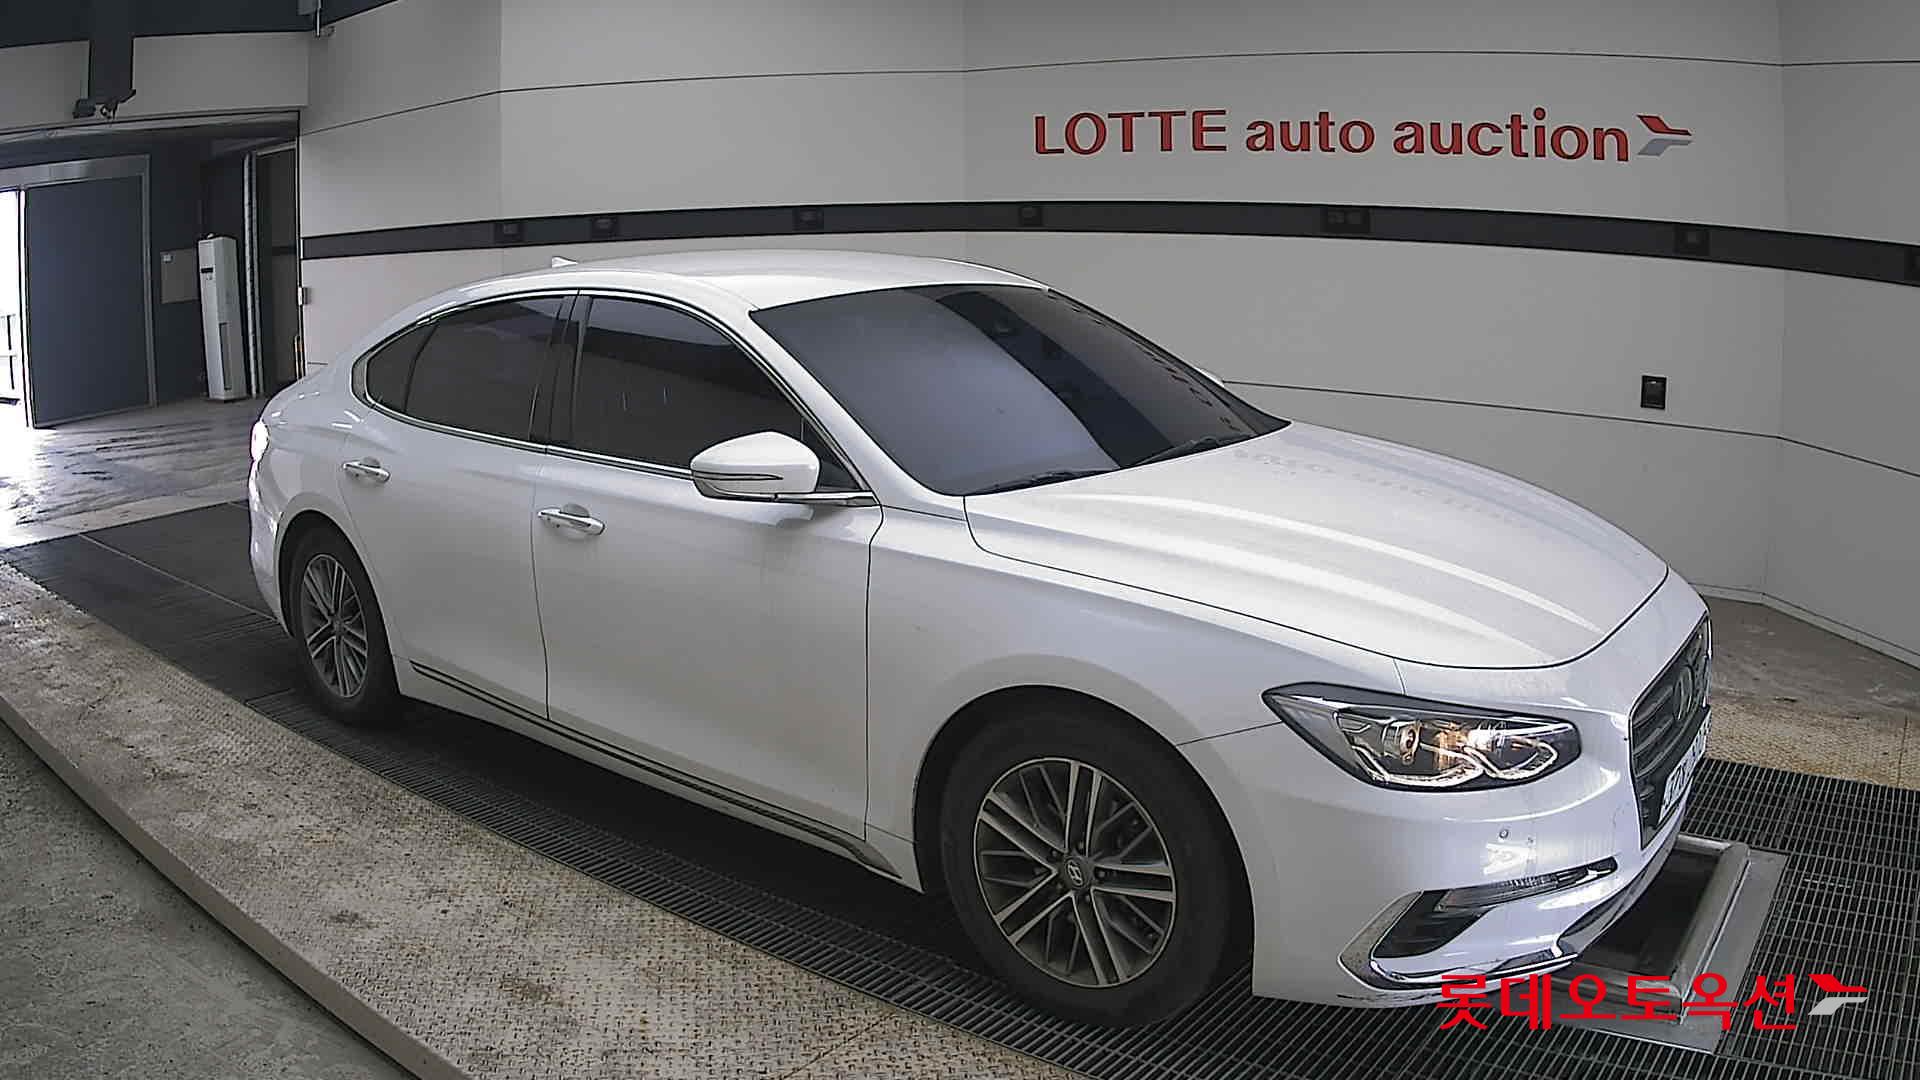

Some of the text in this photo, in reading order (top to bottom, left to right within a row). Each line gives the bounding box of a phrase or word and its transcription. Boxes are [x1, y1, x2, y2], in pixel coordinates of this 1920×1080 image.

[1034, 107, 1629, 161] LOTTE auto auction
